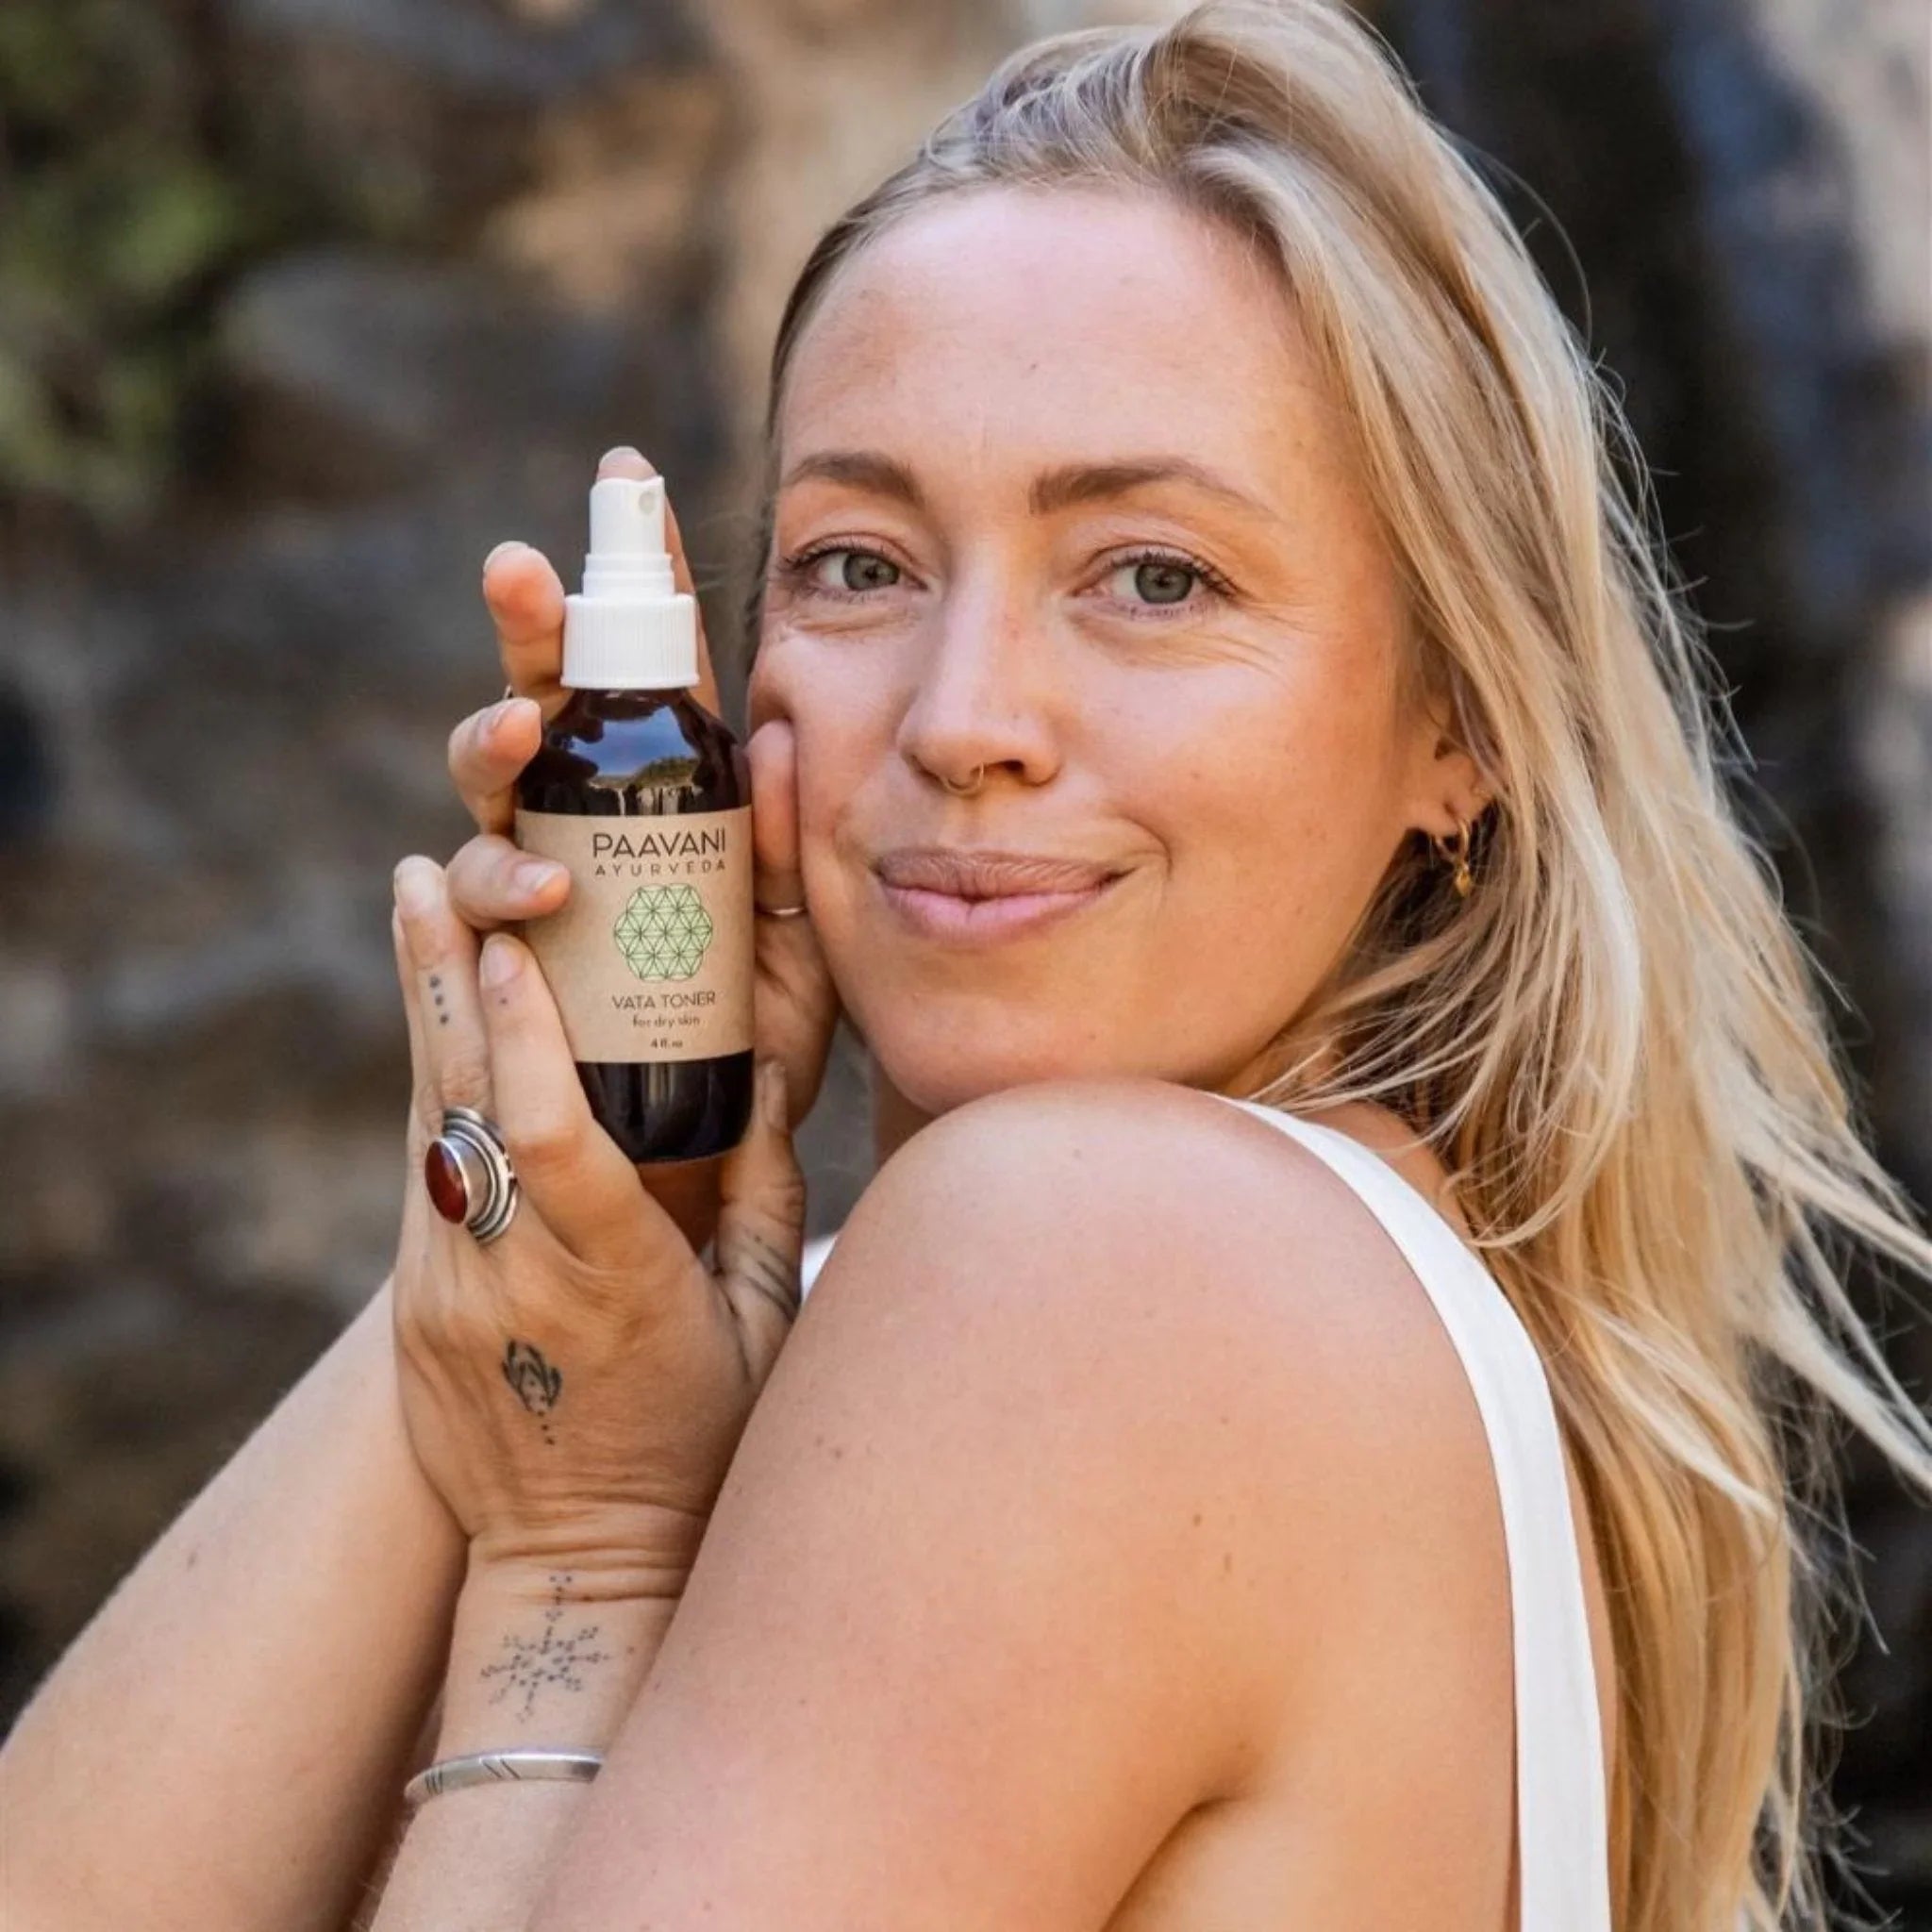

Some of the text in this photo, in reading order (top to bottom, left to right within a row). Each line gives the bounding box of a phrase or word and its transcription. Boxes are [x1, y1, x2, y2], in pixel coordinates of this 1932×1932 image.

[592, 826, 725, 858] PAAVANI
[595, 859, 725, 876] AYURVEDA
[611, 991, 716, 1009] VATA TONER
[633, 1014, 700, 1029] for dry skin
[650, 1038, 658, 1048] 4
